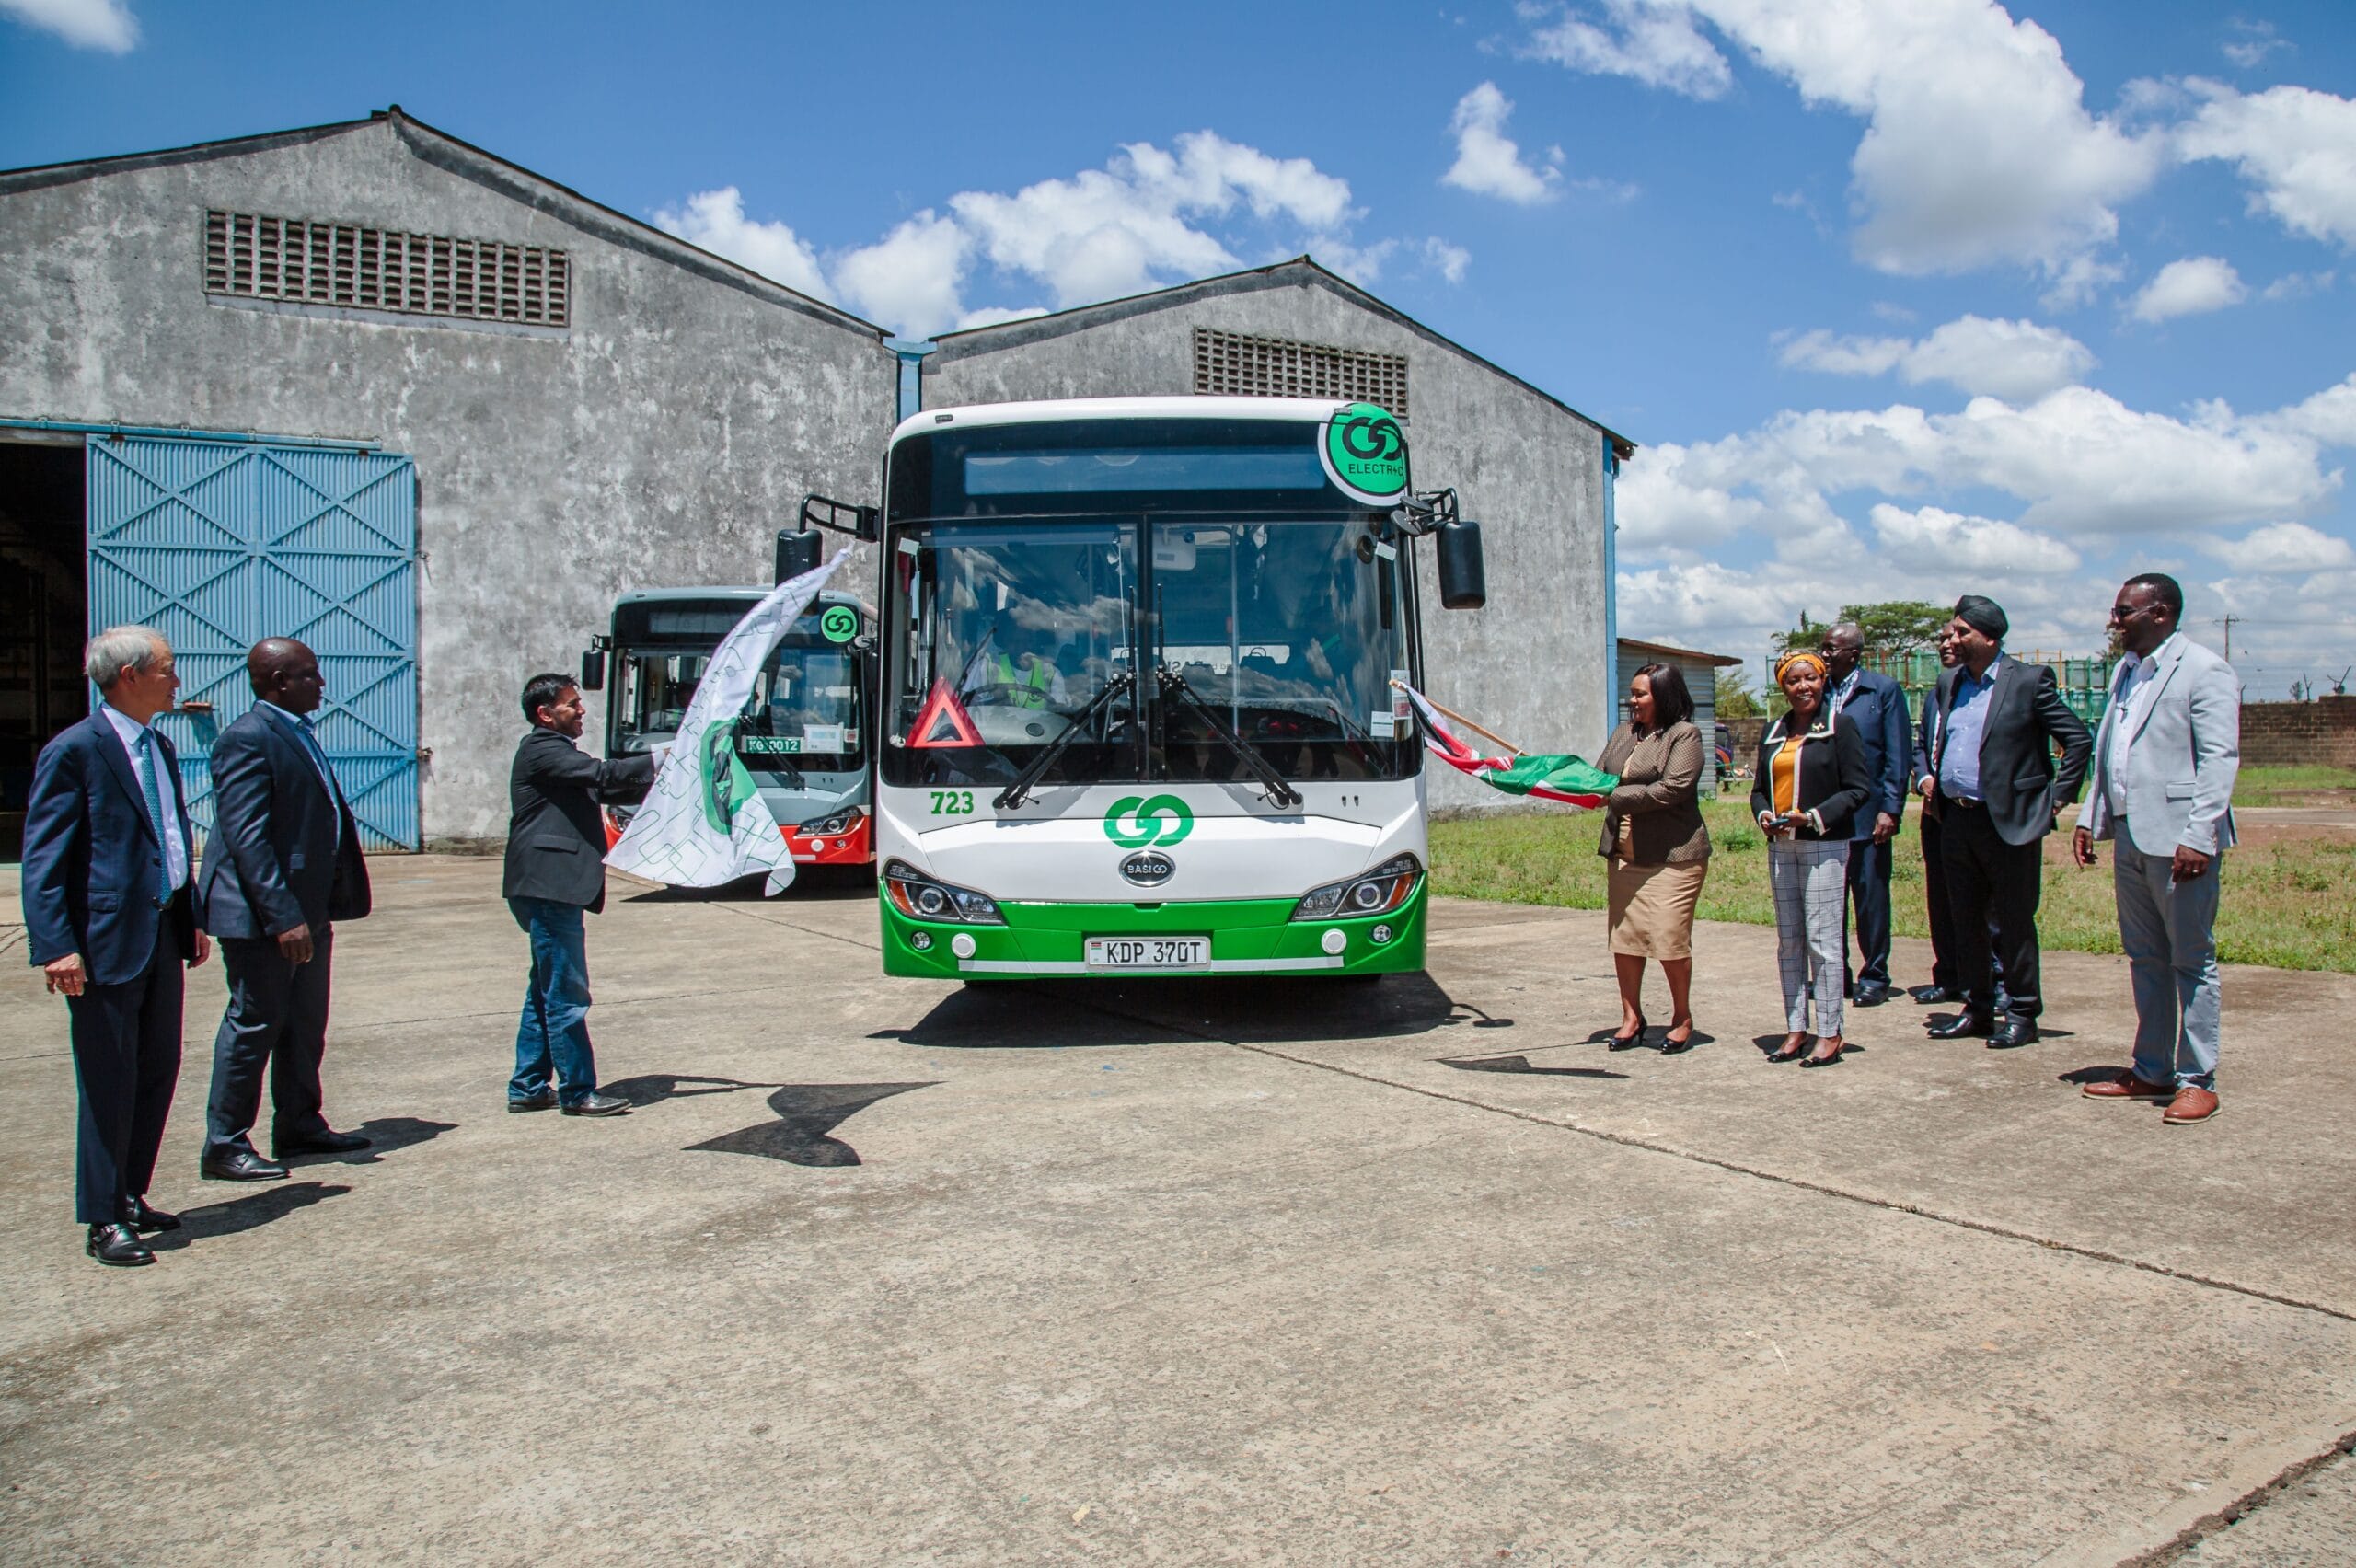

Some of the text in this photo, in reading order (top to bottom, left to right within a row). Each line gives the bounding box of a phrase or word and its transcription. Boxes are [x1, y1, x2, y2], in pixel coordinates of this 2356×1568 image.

[930, 790, 974, 815] 723
[1107, 942, 1201, 963] KDP 370T
